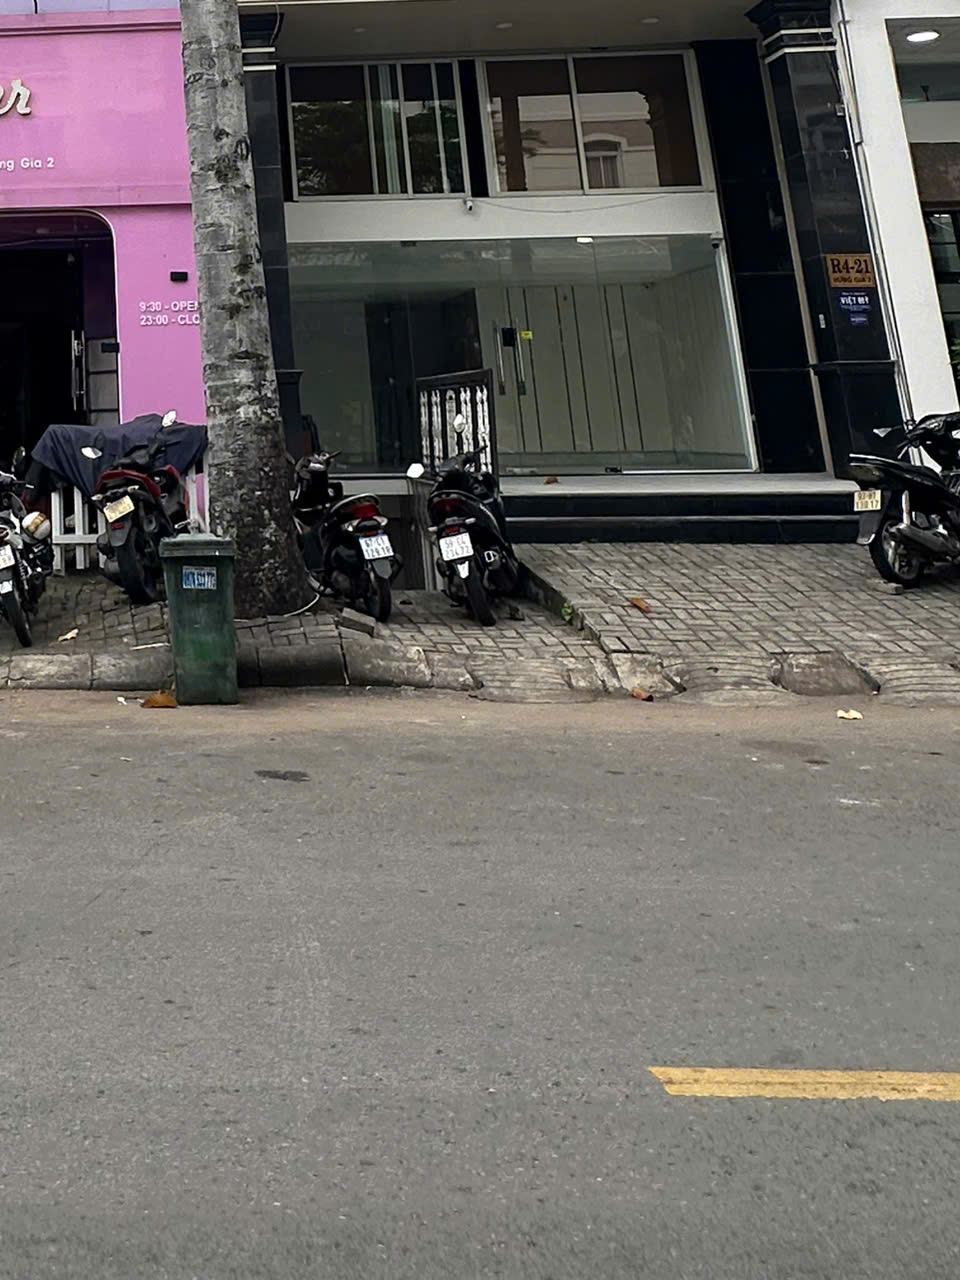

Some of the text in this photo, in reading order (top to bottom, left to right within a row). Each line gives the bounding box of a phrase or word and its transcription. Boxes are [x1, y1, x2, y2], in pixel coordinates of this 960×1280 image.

[20, 157, 43, 169] Gia
[47, 157, 55, 168] 2
[830, 258, 872, 274] R4-21
[139, 301, 162, 312] 9:30
[140, 315, 169, 326] 23:00
[177, 314, 200, 325] CLO
